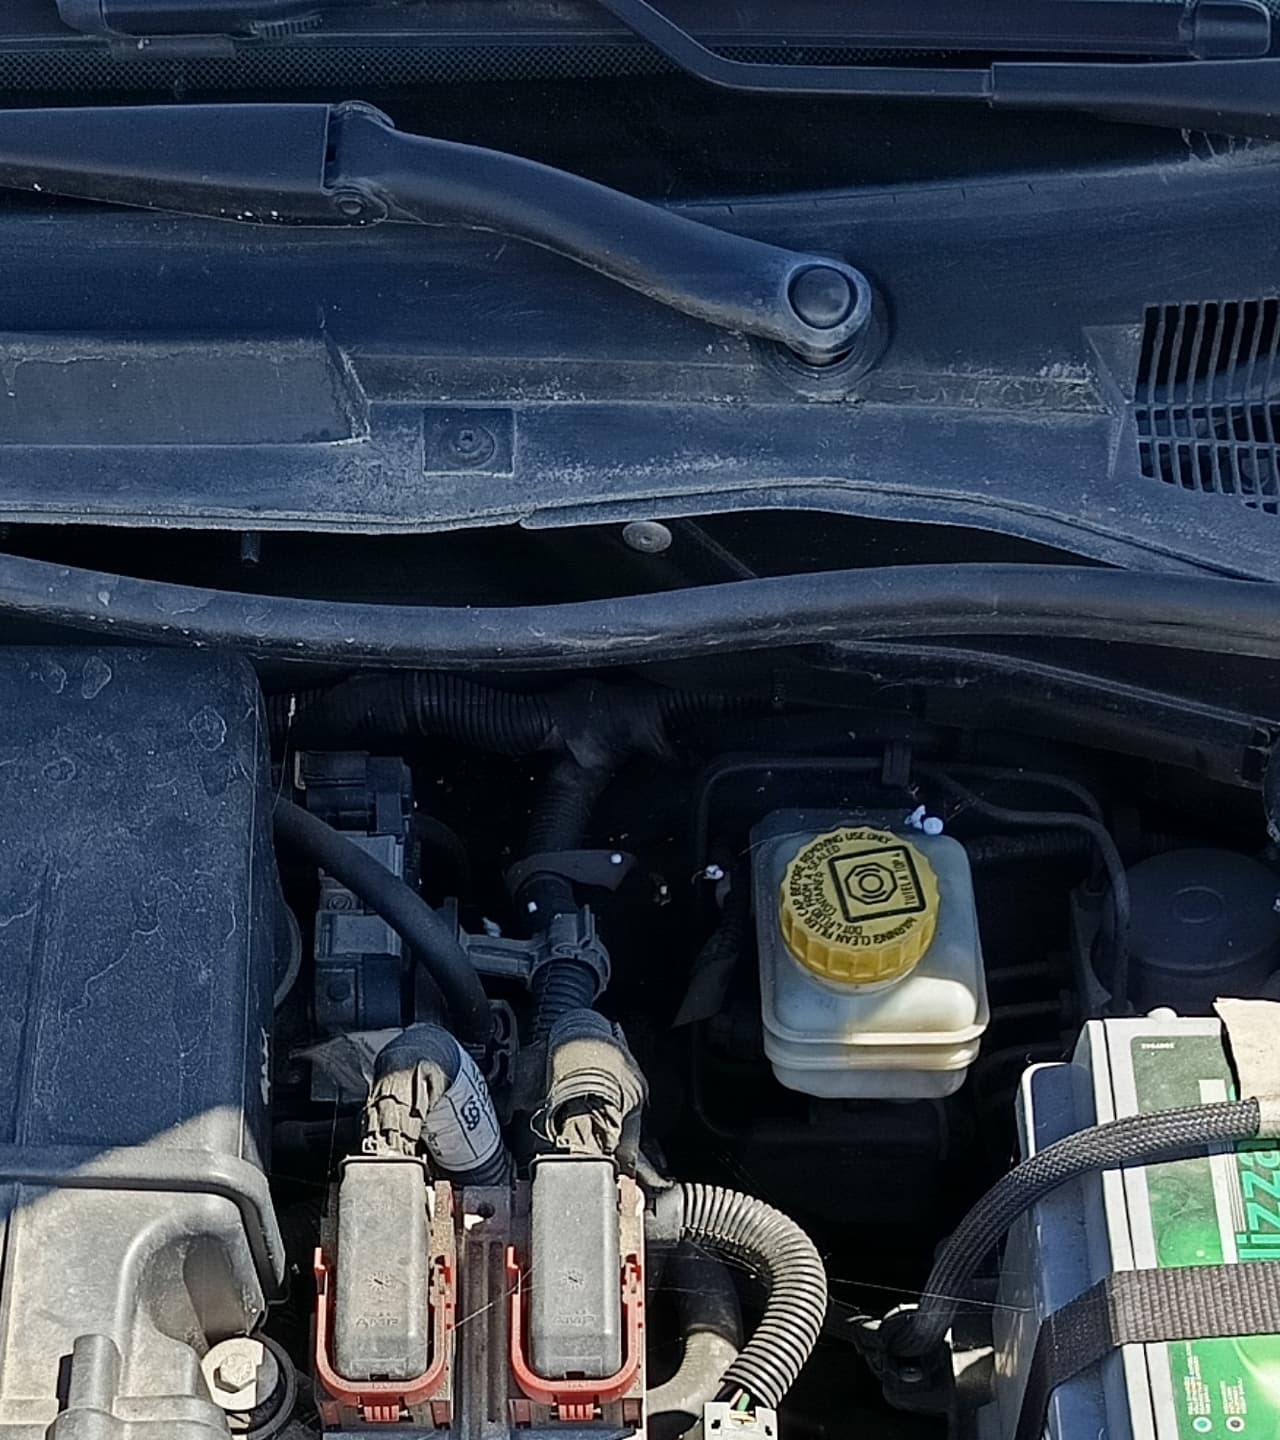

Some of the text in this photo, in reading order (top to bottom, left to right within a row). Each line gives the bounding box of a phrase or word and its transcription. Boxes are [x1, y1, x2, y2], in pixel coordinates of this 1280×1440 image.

[845, 832, 865, 841] USE
[867, 833, 893, 845] ONLY
[800, 833, 844, 864] REMOVING
[807, 845, 841, 871] SEALED
[790, 864, 805, 897] BEFORE
[803, 873, 813, 883] A
[792, 899, 807, 917] CAP
[804, 917, 834, 940] FILLER
[843, 925, 863, 936] DOT
[835, 934, 871, 946] CLEAN
